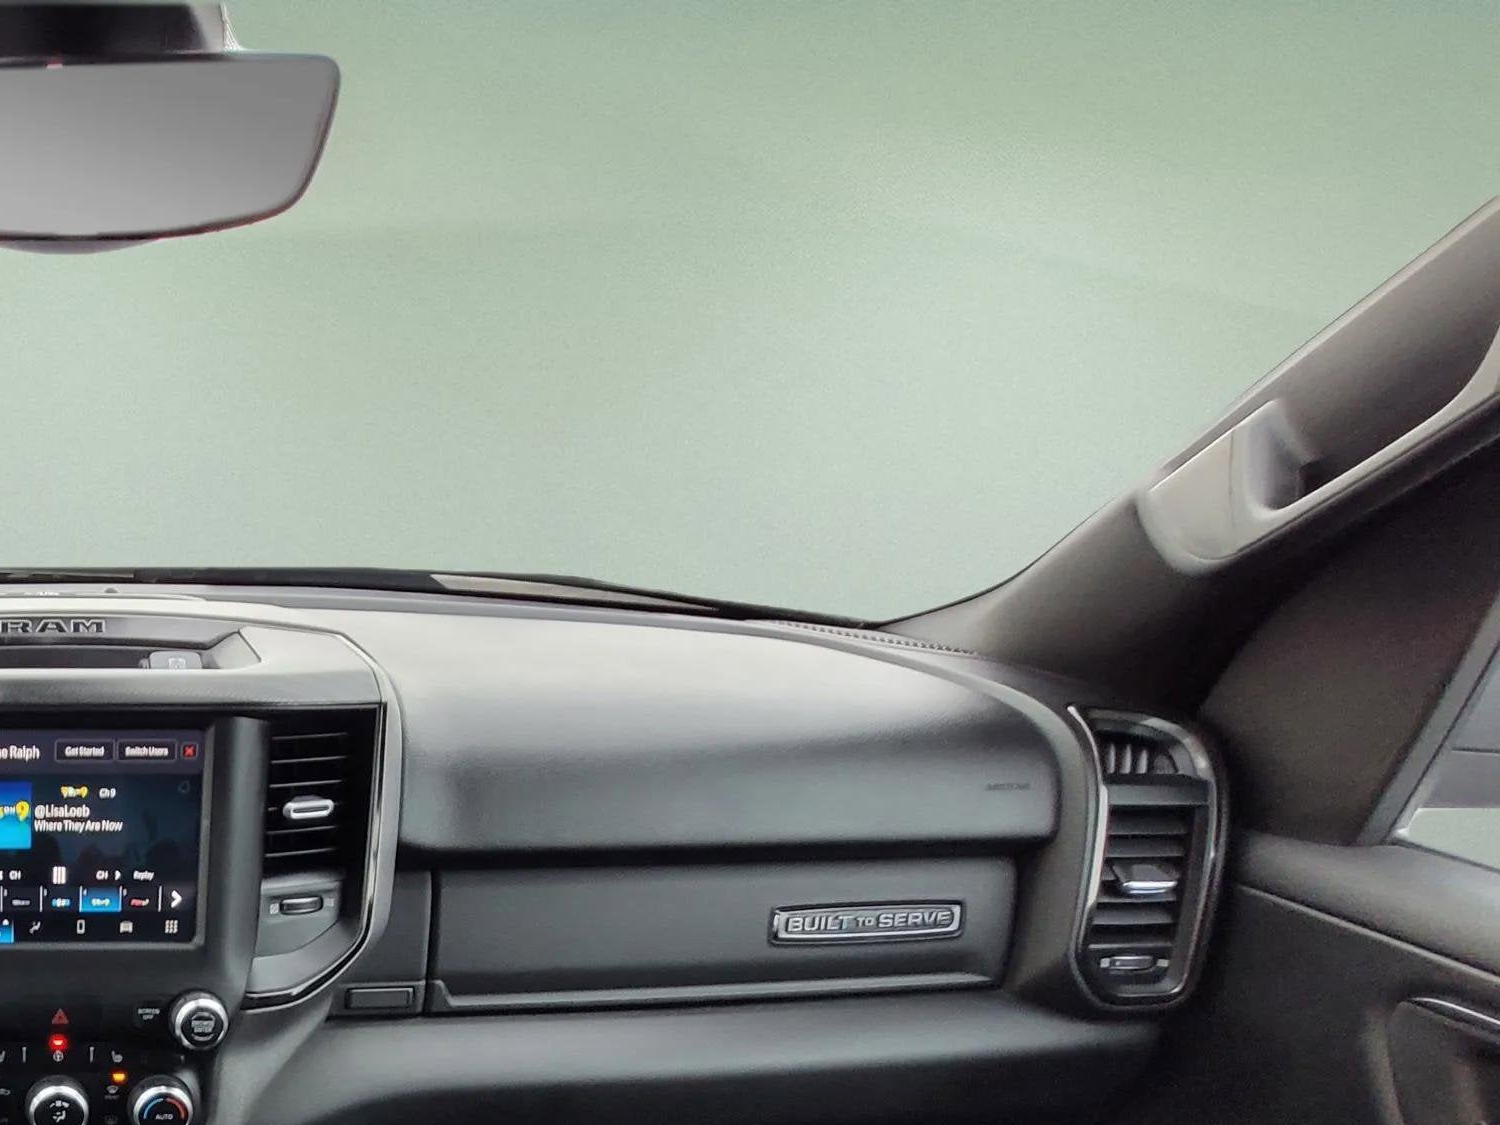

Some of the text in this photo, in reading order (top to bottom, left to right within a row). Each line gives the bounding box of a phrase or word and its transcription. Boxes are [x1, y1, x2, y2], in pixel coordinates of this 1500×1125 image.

[0, 619, 106, 633] RAM
[9, 745, 40, 763] Ralph
[34, 804, 90, 819] @LisaLoeb
[34, 820, 123, 834] Where They Are Now
[787, 911, 951, 932] BUILT TO SERVE
